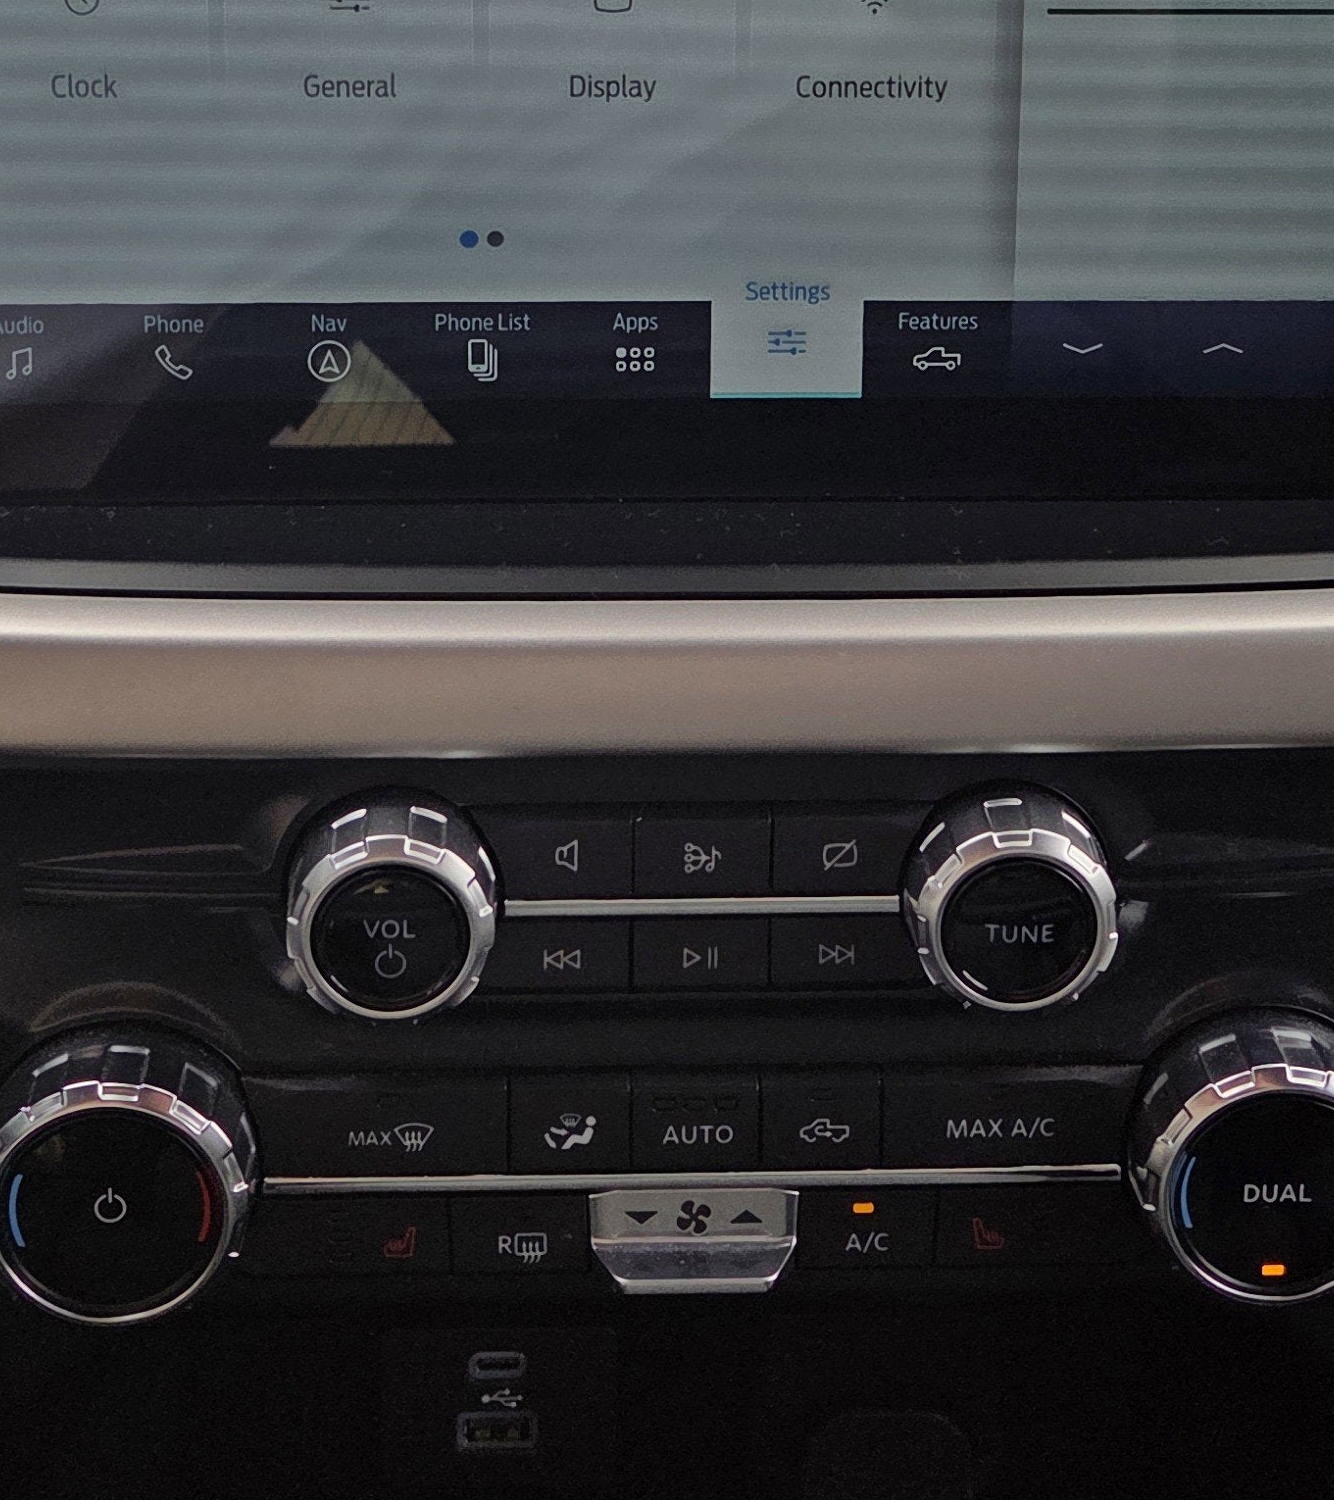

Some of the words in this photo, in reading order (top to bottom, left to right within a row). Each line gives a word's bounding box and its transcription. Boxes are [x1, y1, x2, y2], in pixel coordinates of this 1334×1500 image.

[51, 72, 118, 99] Clock
[303, 71, 397, 98] General
[569, 73, 657, 102] Display
[796, 74, 948, 103] Connectivity
[745, 280, 831, 305] Settings
[143, 315, 205, 334] Phone
[311, 314, 347, 332] Nav
[434, 313, 494, 332] Phone
[497, 313, 530, 332] List
[612, 312, 659, 334] Apps
[898, 311, 979, 331] Features
[363, 919, 416, 939] VOL
[985, 923, 1054, 944] TUNE
[348, 1131, 392, 1146] MAX
[662, 1124, 734, 1145] AUTO
[946, 1118, 1003, 1139] MAX
[1011, 1117, 1054, 1139] A/C
[1243, 1183, 1312, 1203] DUAL
[498, 1235, 512, 1254] R
[845, 1231, 888, 1253] A/C
